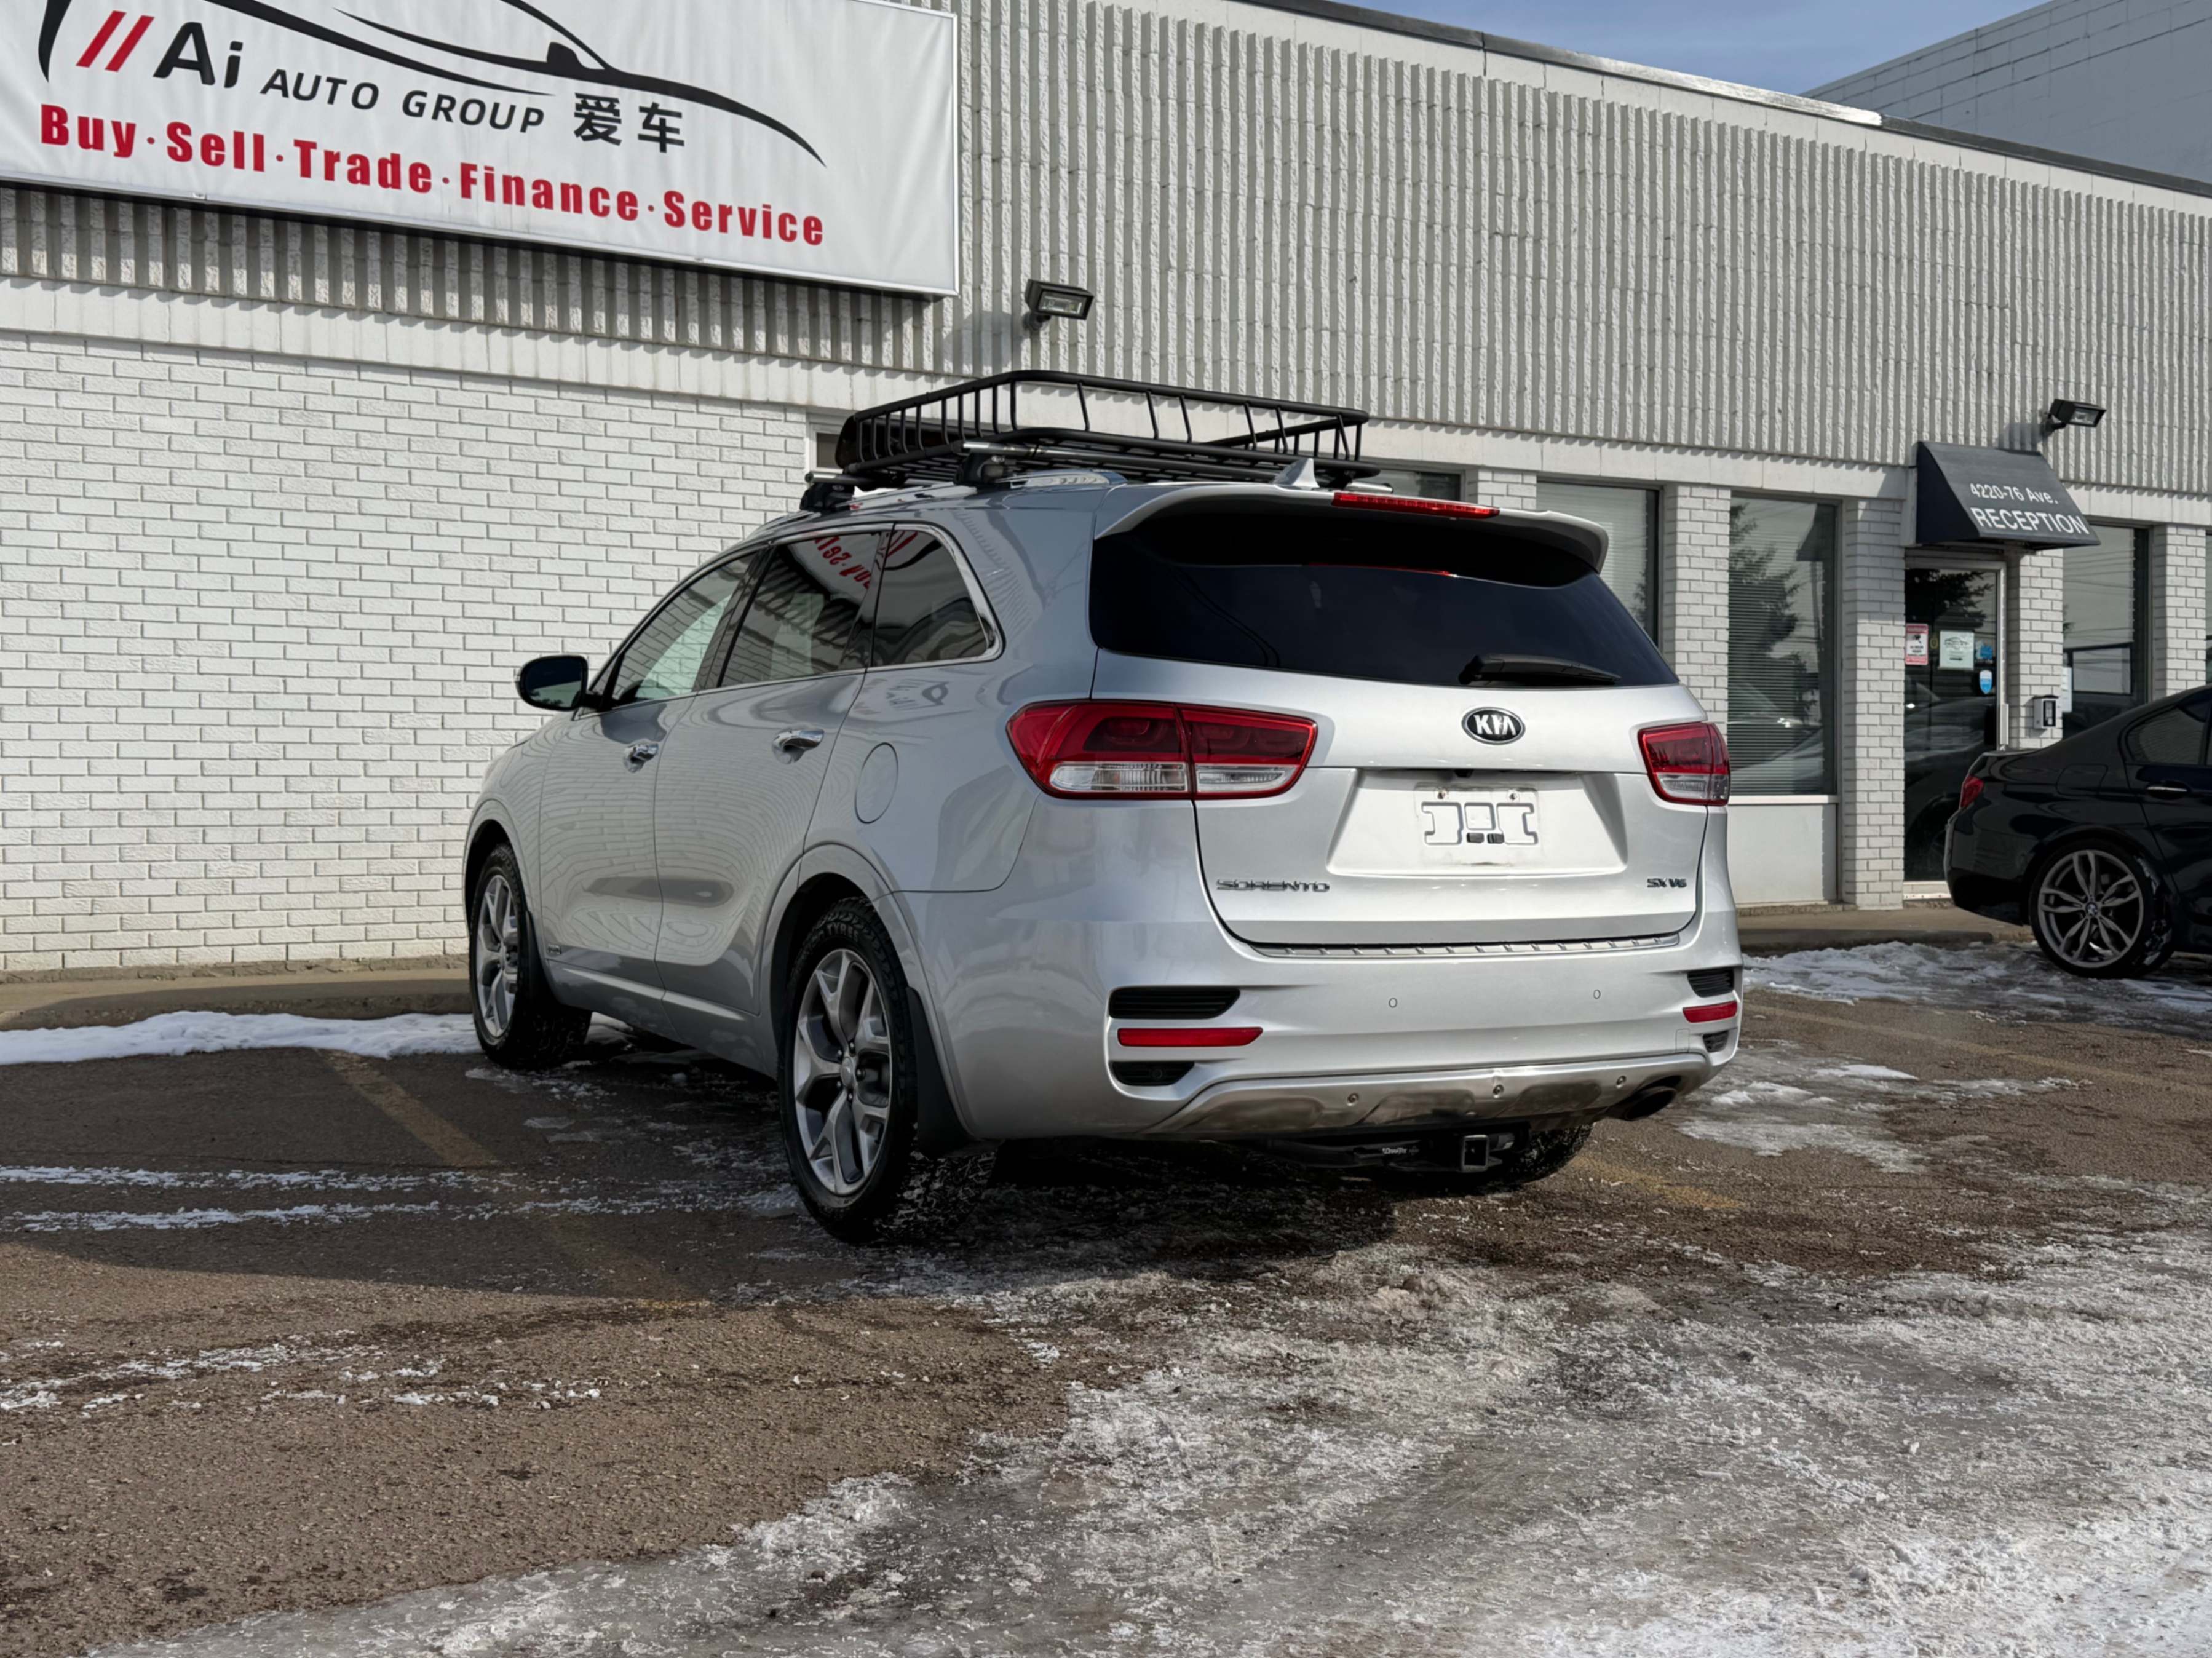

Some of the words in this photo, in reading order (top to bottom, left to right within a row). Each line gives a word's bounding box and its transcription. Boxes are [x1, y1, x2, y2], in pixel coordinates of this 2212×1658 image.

[153, 22, 243, 89] Ai
[261, 69, 379, 110] AUTO
[403, 91, 544, 133] GROUP
[574, 93, 684, 153] 爱车
[41, 104, 136, 158] Buy
[167, 122, 264, 172] Sell
[294, 140, 432, 194] Trade
[460, 163, 638, 221] Finance
[664, 191, 823, 246] Service
[1970, 483, 2024, 501] 4220-76
[2026, 487, 2059, 504] Ave.
[1970, 507, 2090, 534] RECEPTION
[1473, 714, 1517, 736] KIA
[1216, 879, 1330, 892] SORENTO
